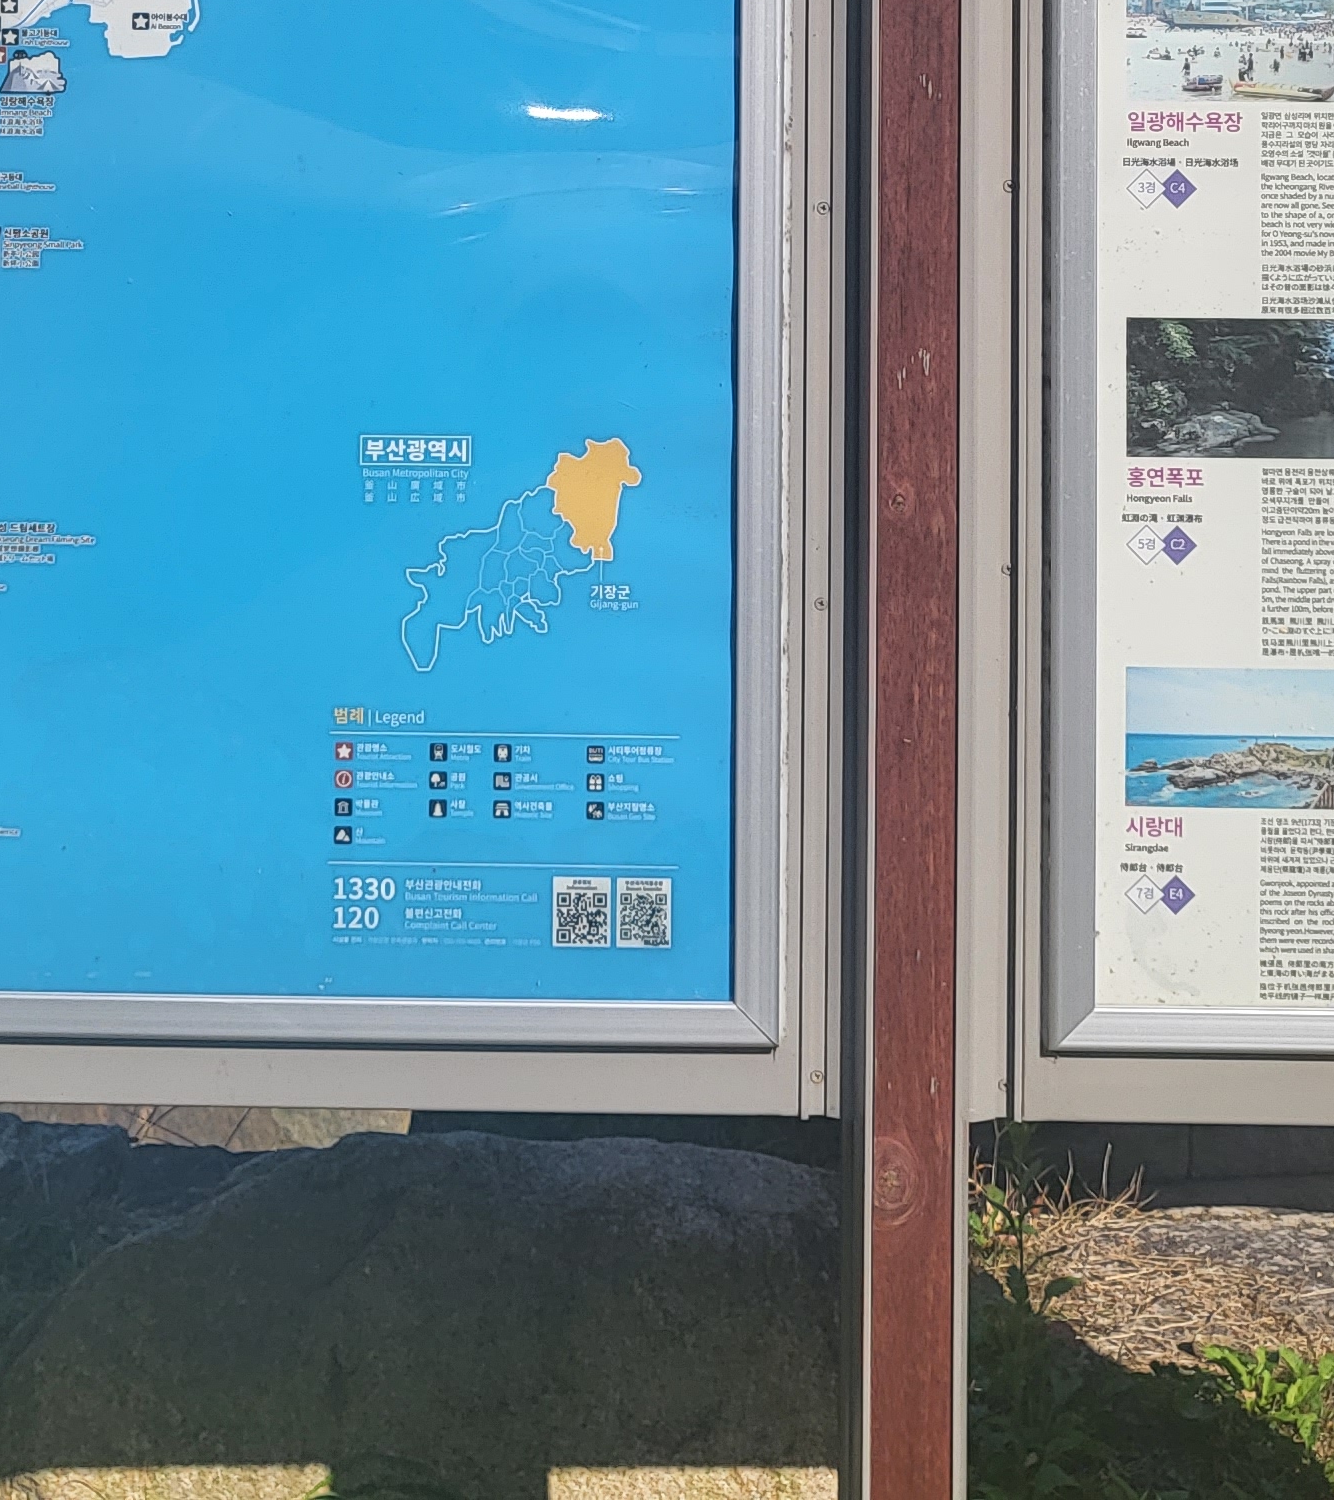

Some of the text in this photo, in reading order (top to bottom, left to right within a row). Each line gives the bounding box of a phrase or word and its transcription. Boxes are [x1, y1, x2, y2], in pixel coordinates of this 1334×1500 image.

[1128, 112, 1243, 132] 일광해수욕장
[1127, 138, 1161, 148] Ilgwang
[1137, 179, 1157, 195] 3경
[1169, 181, 1186, 193] C4
[365, 439, 466, 462] 부산광역시
[363, 468, 469, 481] Busan Metropolitan City
[1127, 467, 1204, 488] 홍연폭포
[1127, 494, 1171, 504] Hongyeon
[1137, 537, 1157, 552] 5경
[1169, 539, 1186, 550] C2
[591, 585, 630, 601] 기장군
[590, 598, 638, 611] Gijang-gun
[334, 707, 364, 724] 범례
[374, 711, 426, 727] Legend
[1126, 816, 1182, 837] 시랑대
[1125, 843, 1168, 854] Sirangdae
[333, 877, 396, 900] 1330
[406, 878, 481, 893] 부산관광안내전화
[1135, 887, 1155, 902] 7경
[1169, 889, 1184, 900] E4
[333, 907, 380, 929] 120
